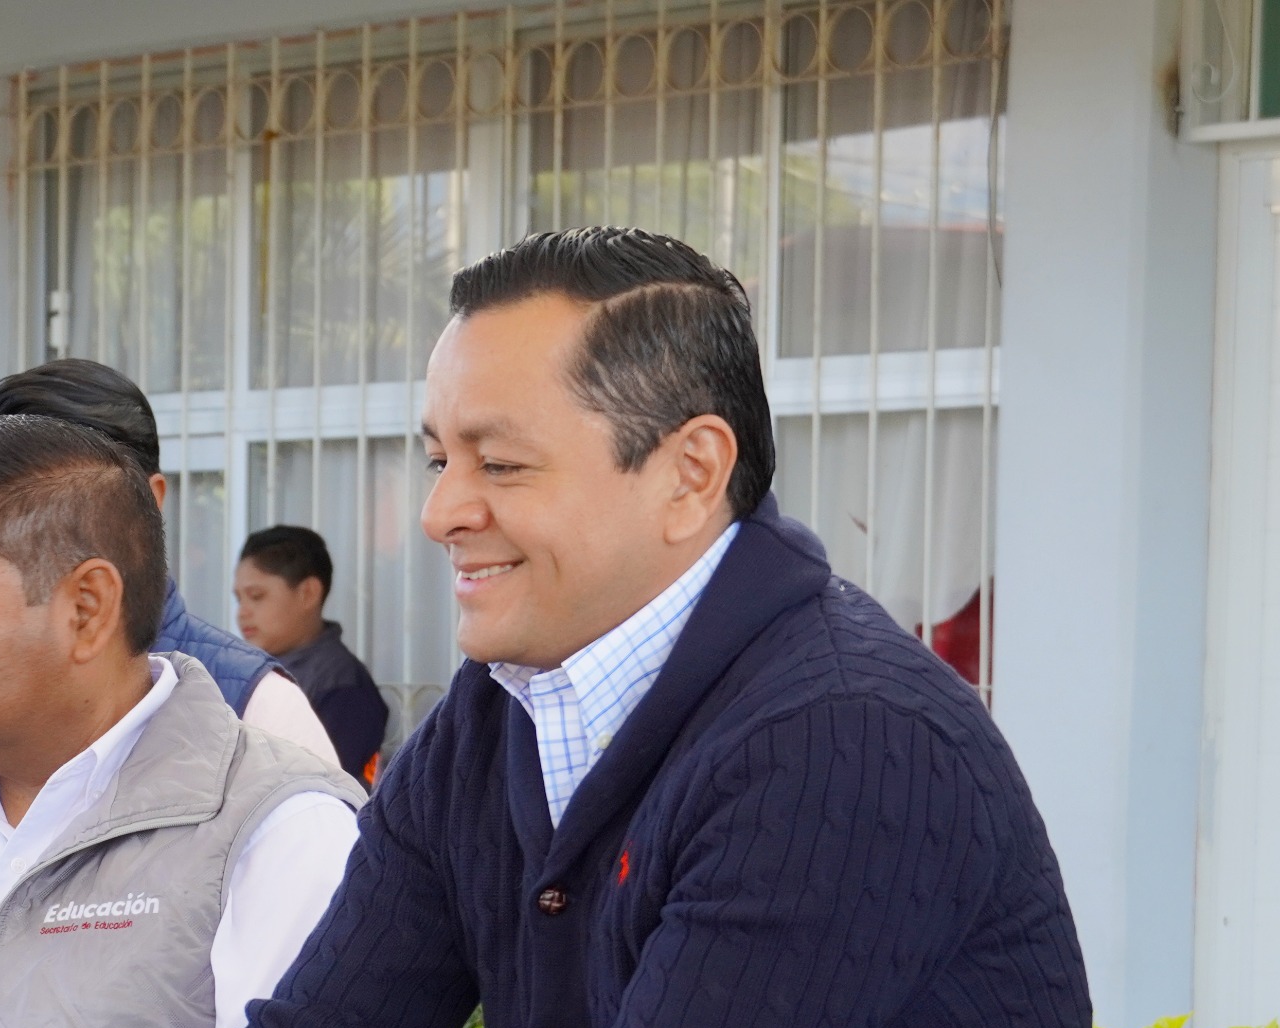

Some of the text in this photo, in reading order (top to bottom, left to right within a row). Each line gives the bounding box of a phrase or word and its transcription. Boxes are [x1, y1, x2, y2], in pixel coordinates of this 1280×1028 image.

[43, 892, 160, 923] Educación
[81, 921, 91, 930] de
[94, 919, 133, 930] Educación
